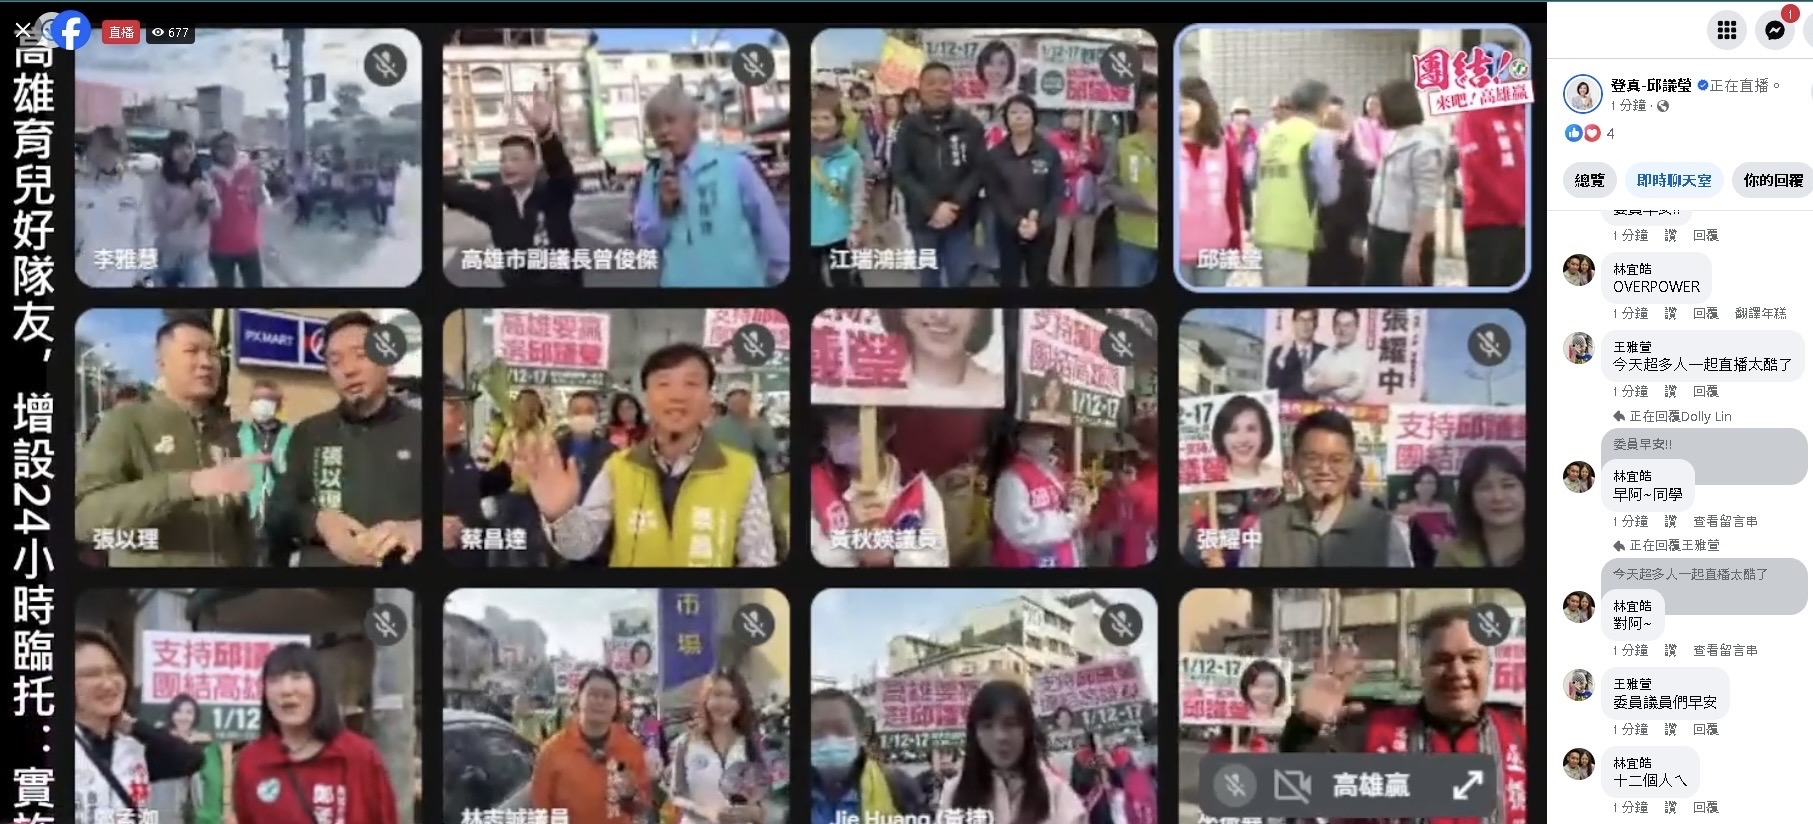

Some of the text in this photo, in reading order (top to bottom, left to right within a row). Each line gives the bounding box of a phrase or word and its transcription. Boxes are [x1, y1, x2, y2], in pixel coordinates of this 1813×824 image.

[108, 26, 135, 39] 直播
[168, 27, 189, 38] 677
[1610, 78, 1692, 93] 登真-邱議瑩
[1620, 99, 1647, 112] 分鐘
[1606, 128, 1615, 140] 4
[1574, 173, 1606, 188] 總覽
[1636, 173, 1712, 188] 即時聊天室
[1743, 173, 1804, 188] 你的回覆
[1622, 229, 1649, 242] 分鐘
[1664, 229, 1678, 243] 讚
[1693, 229, 1720, 242] 回覆
[1613, 280, 1701, 293] OVERPOWER
[1622, 307, 1649, 320] 分鐘
[1664, 307, 1678, 321] 讚
[1693, 307, 1720, 320] 回覆
[1734, 306, 1787, 320] 翻譯年糕
[1613, 341, 1652, 354] 王雅萱
[1612, 357, 1792, 372] 今天超多人一起直播太酷了
[1622, 385, 1649, 398] 分鐘
[1664, 385, 1678, 399] 讚
[1693, 385, 1720, 398] 回覆
[1715, 411, 1732, 422] Lin
[1622, 515, 1649, 528] 分鐘
[1664, 515, 1678, 529] 讚
[1693, 514, 1758, 528] 查看留言串
[1629, 539, 1720, 552] 正在回覆王雅萱
[1612, 568, 1768, 581] 今天超多人一起直播太酷了
[1622, 644, 1649, 657] 分鐘
[1664, 644, 1678, 658] 讚
[1693, 643, 1758, 657] 查看留言串
[1613, 678, 1652, 691] 王雅萱
[1613, 695, 1717, 710] 委員議員們早安
[1622, 723, 1649, 736] 分鐘
[1664, 723, 1678, 737] 讚
[1693, 723, 1720, 736] 回覆
[1622, 801, 1649, 814] 分鐘
[1664, 801, 1678, 815] 讚
[1693, 801, 1720, 814] 回覆
